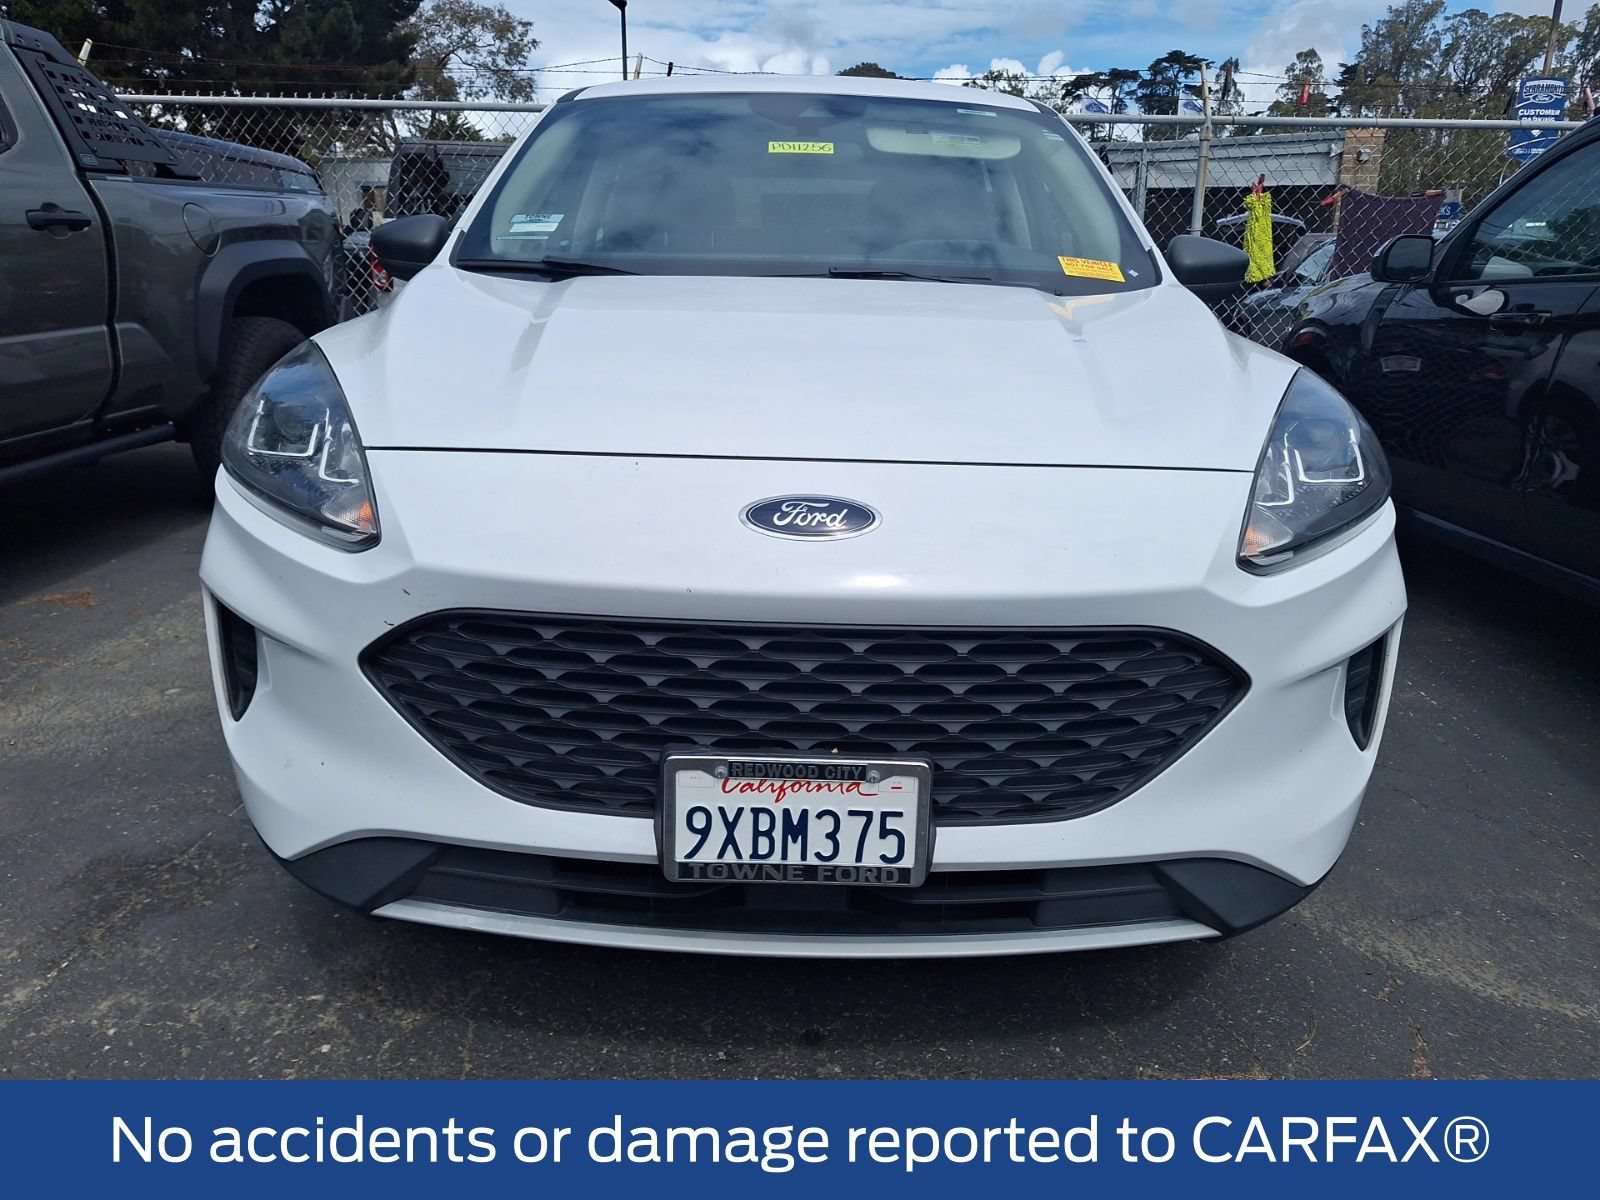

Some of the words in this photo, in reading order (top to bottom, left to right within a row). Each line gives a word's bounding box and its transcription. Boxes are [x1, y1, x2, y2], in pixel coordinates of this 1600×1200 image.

[773, 501, 848, 528] Ford
[732, 762, 819, 779] REDWOOD
[825, 764, 863, 780] CITY
[721, 778, 879, 803] California
[683, 806, 906, 864] 9XBM375
[688, 863, 804, 881] TOWNE
[817, 866, 900, 884] FORD
